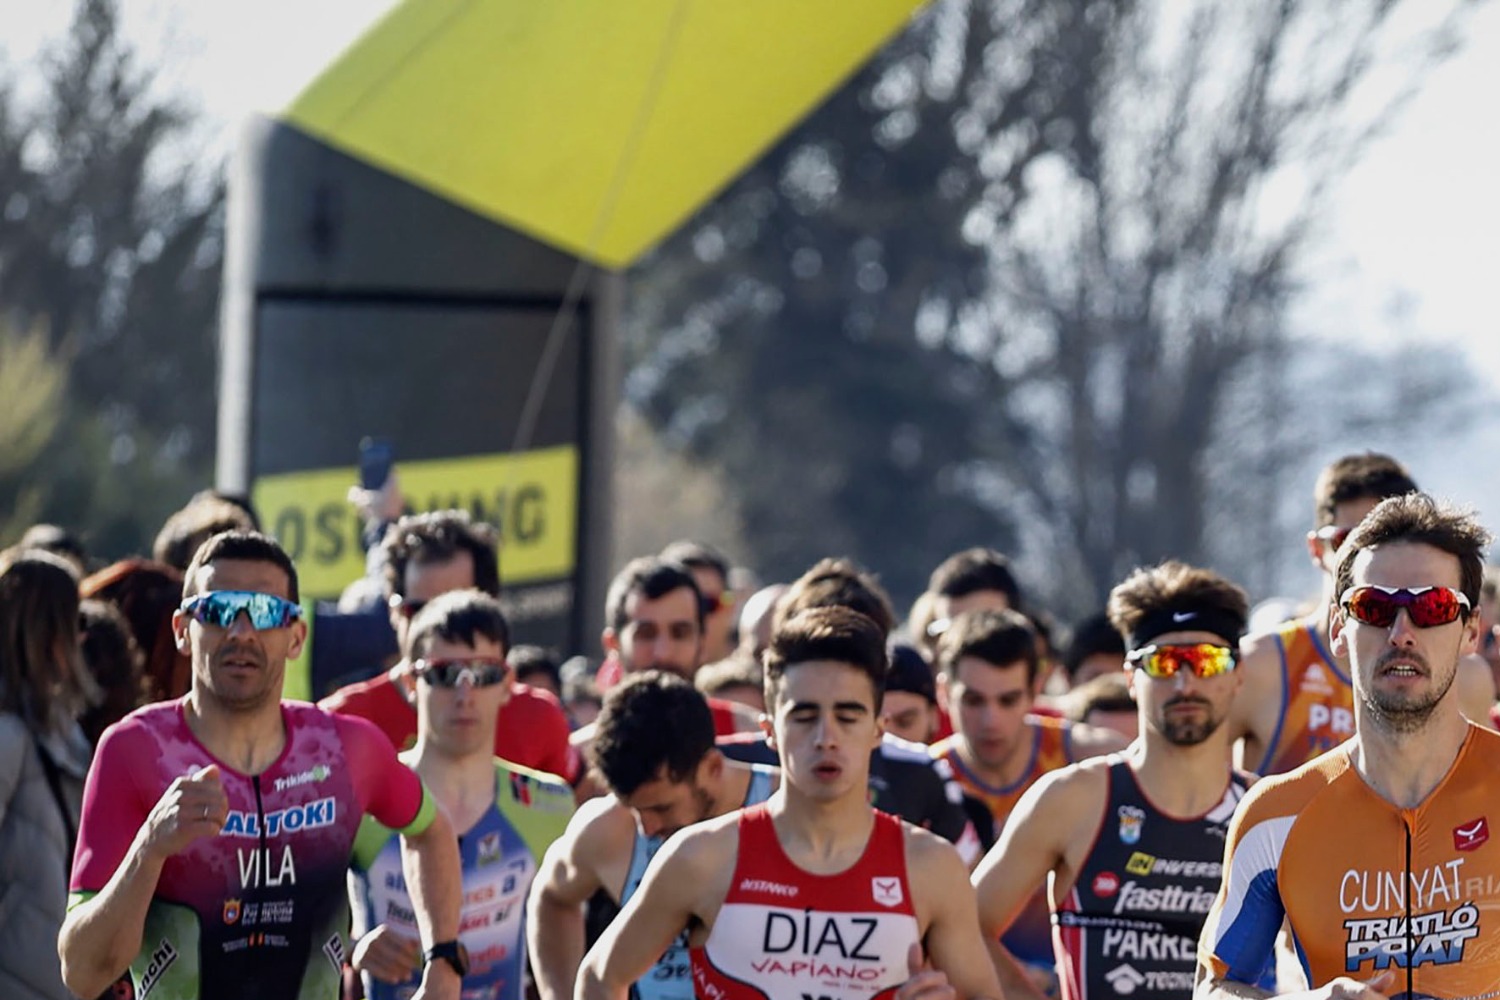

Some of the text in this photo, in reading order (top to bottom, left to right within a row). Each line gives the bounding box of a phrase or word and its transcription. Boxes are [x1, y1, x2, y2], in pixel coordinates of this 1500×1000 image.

[237, 844, 296, 889] VILA
[762, 906, 881, 962] DÍAZ
[1344, 925, 1480, 974] PRAT
